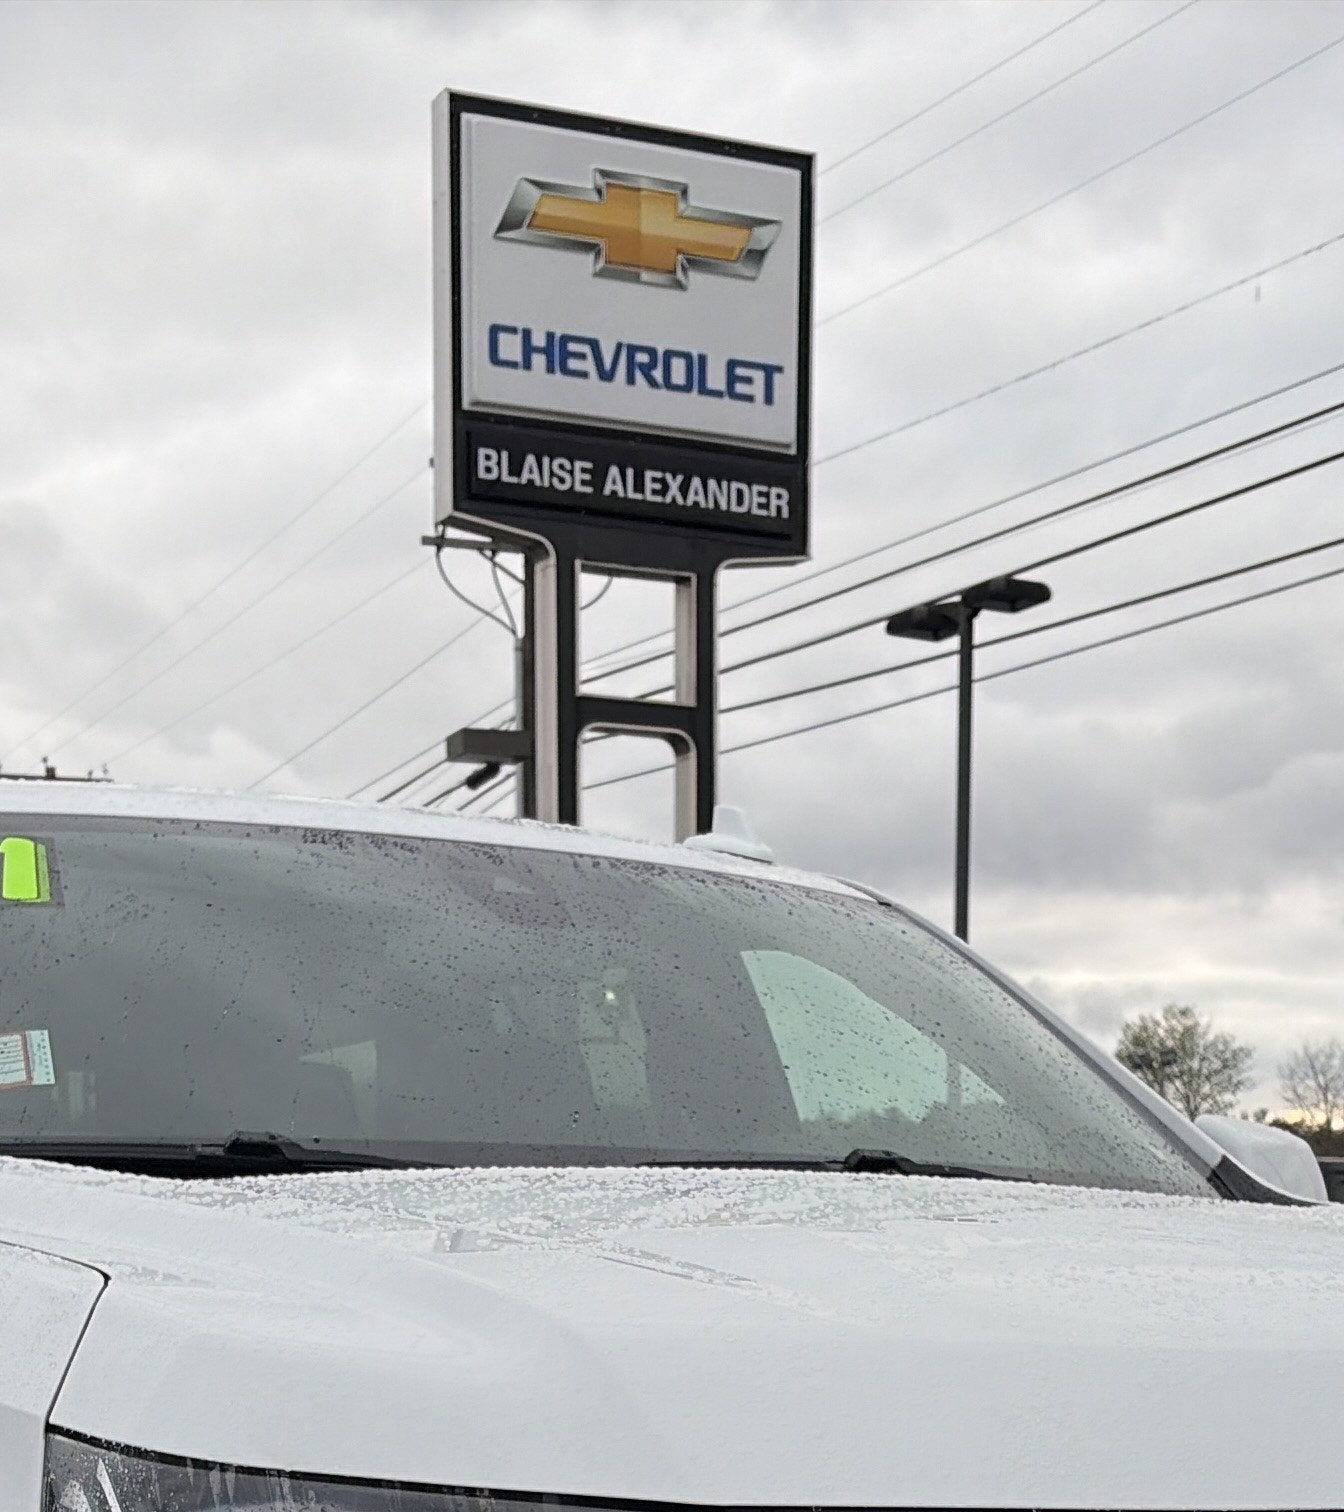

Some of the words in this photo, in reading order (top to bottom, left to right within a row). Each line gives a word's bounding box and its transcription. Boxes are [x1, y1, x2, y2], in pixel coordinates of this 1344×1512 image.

[488, 322, 784, 406] CHEVROLET
[476, 447, 594, 494] BLAISE
[602, 464, 791, 520] ALEXANDER
